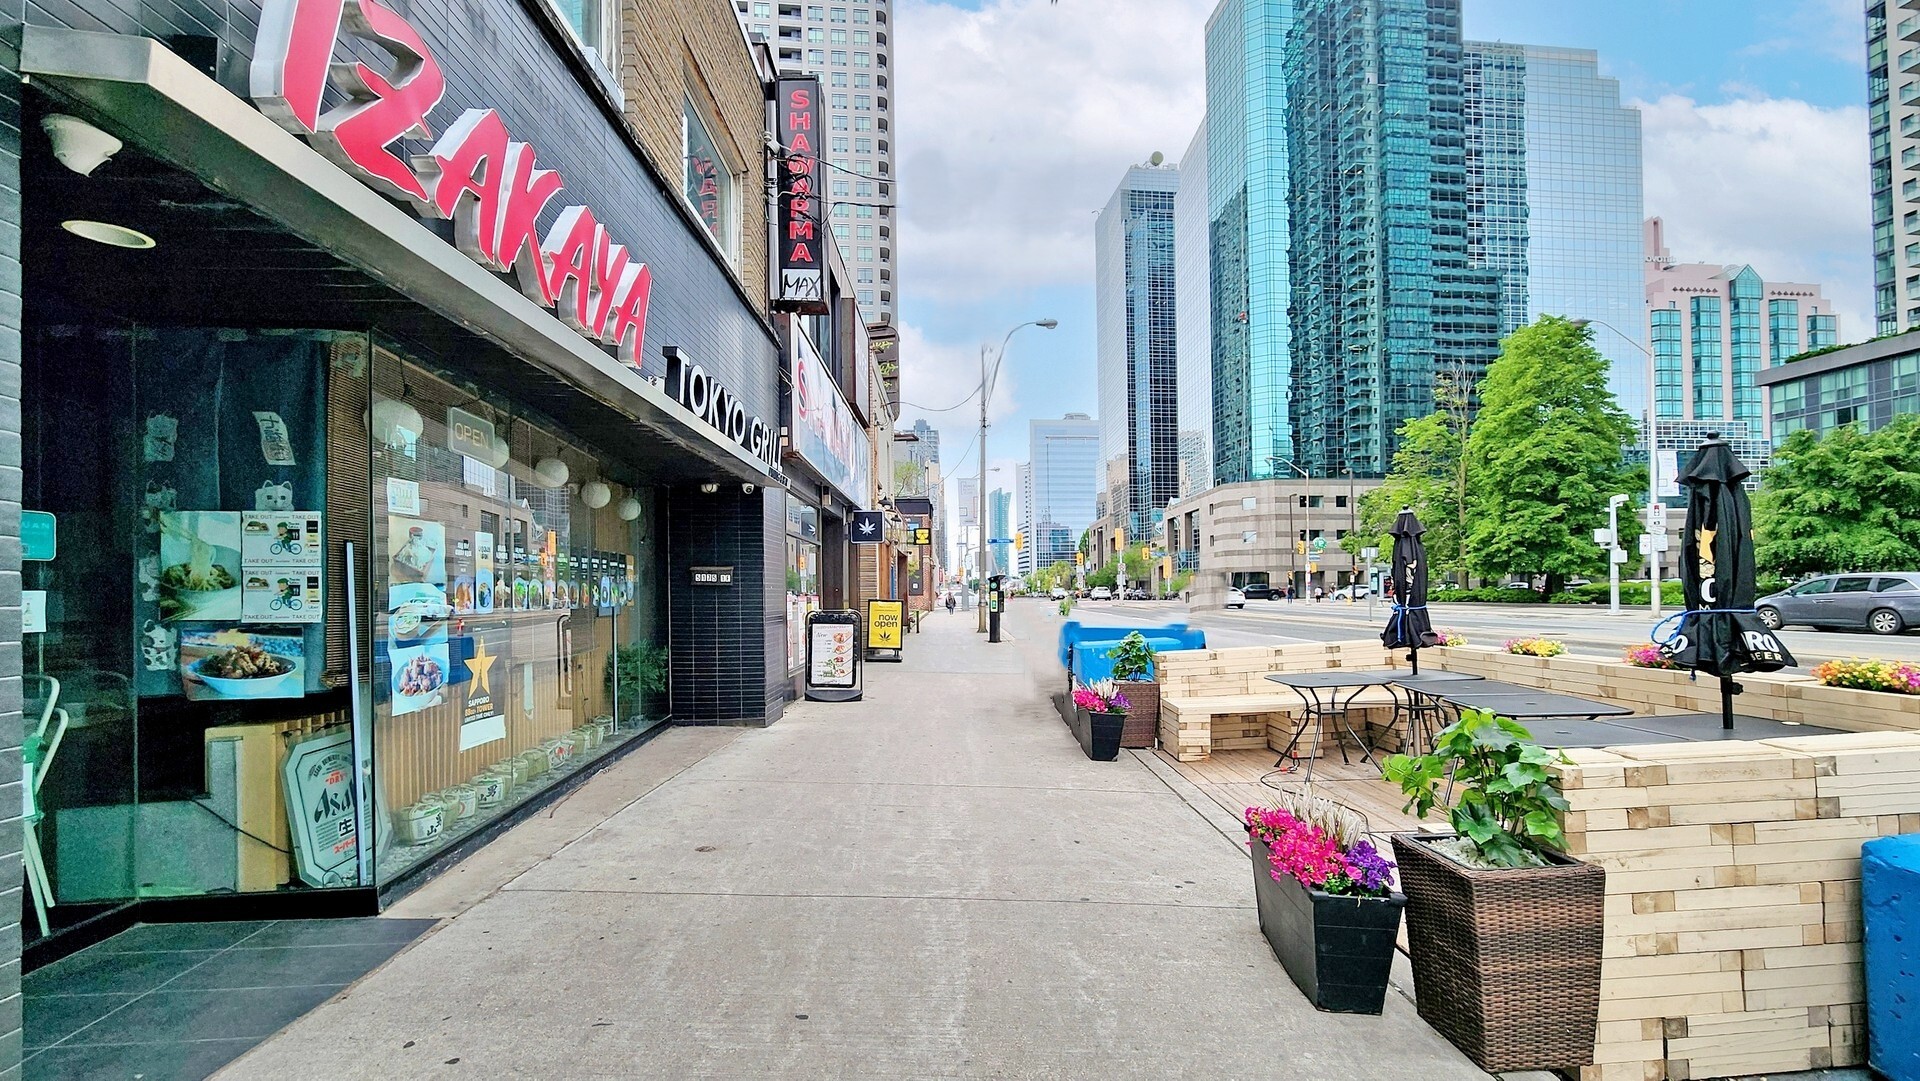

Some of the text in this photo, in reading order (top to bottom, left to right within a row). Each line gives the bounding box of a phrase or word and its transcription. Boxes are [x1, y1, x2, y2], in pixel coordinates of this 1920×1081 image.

[250, 0, 653, 370] IZAKAYA
[789, 88, 815, 263] SHAWARMA
[783, 272, 822, 298] MAX
[663, 346, 746, 446] TOKYO
[750, 416, 784, 473] GRILL
[454, 422, 490, 449] OPEN
[874, 620, 898, 629] open
[878, 613, 899, 621] now
[469, 696, 489, 707] SAPPORO
[476, 703, 493, 713] TOWER
[338, 818, 355, 837] 生
